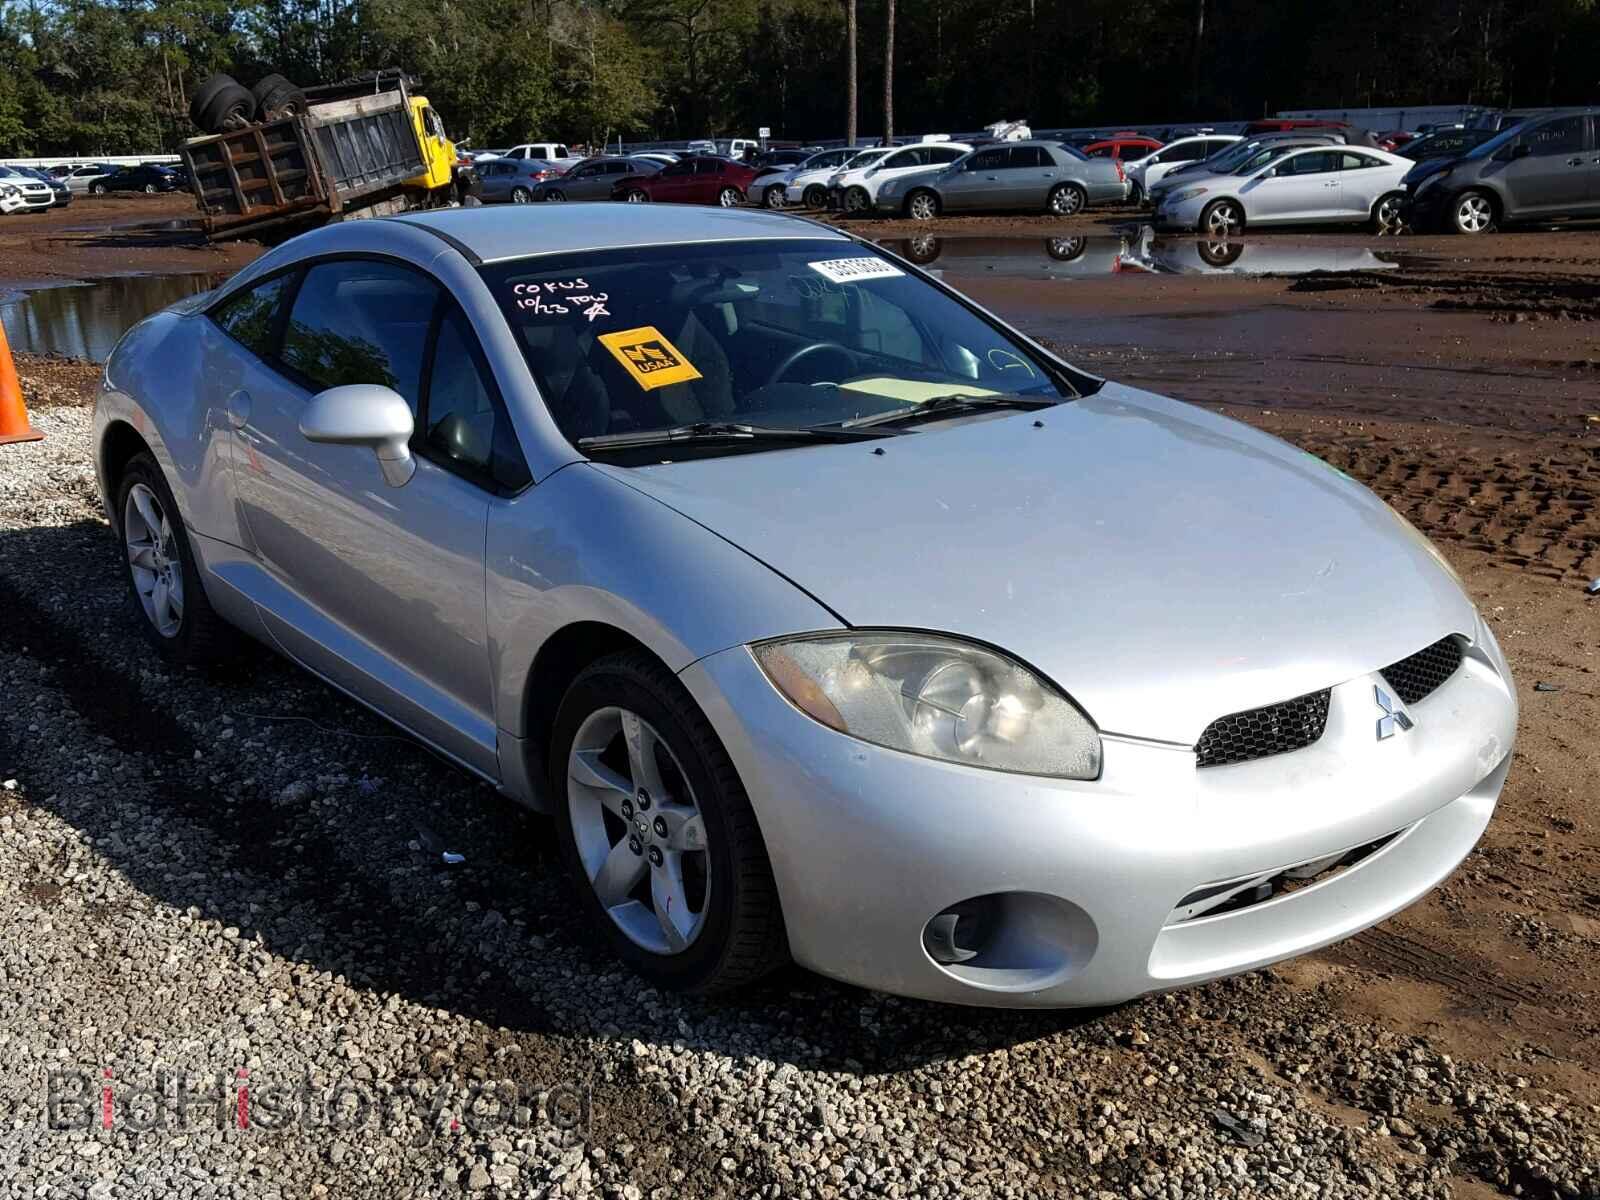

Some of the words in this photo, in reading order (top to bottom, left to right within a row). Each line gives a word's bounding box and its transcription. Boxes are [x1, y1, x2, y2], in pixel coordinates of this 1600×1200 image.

[517, 295, 569, 314] 10/23
[565, 292, 609, 305] TOW
[638, 358, 675, 373] USAA
